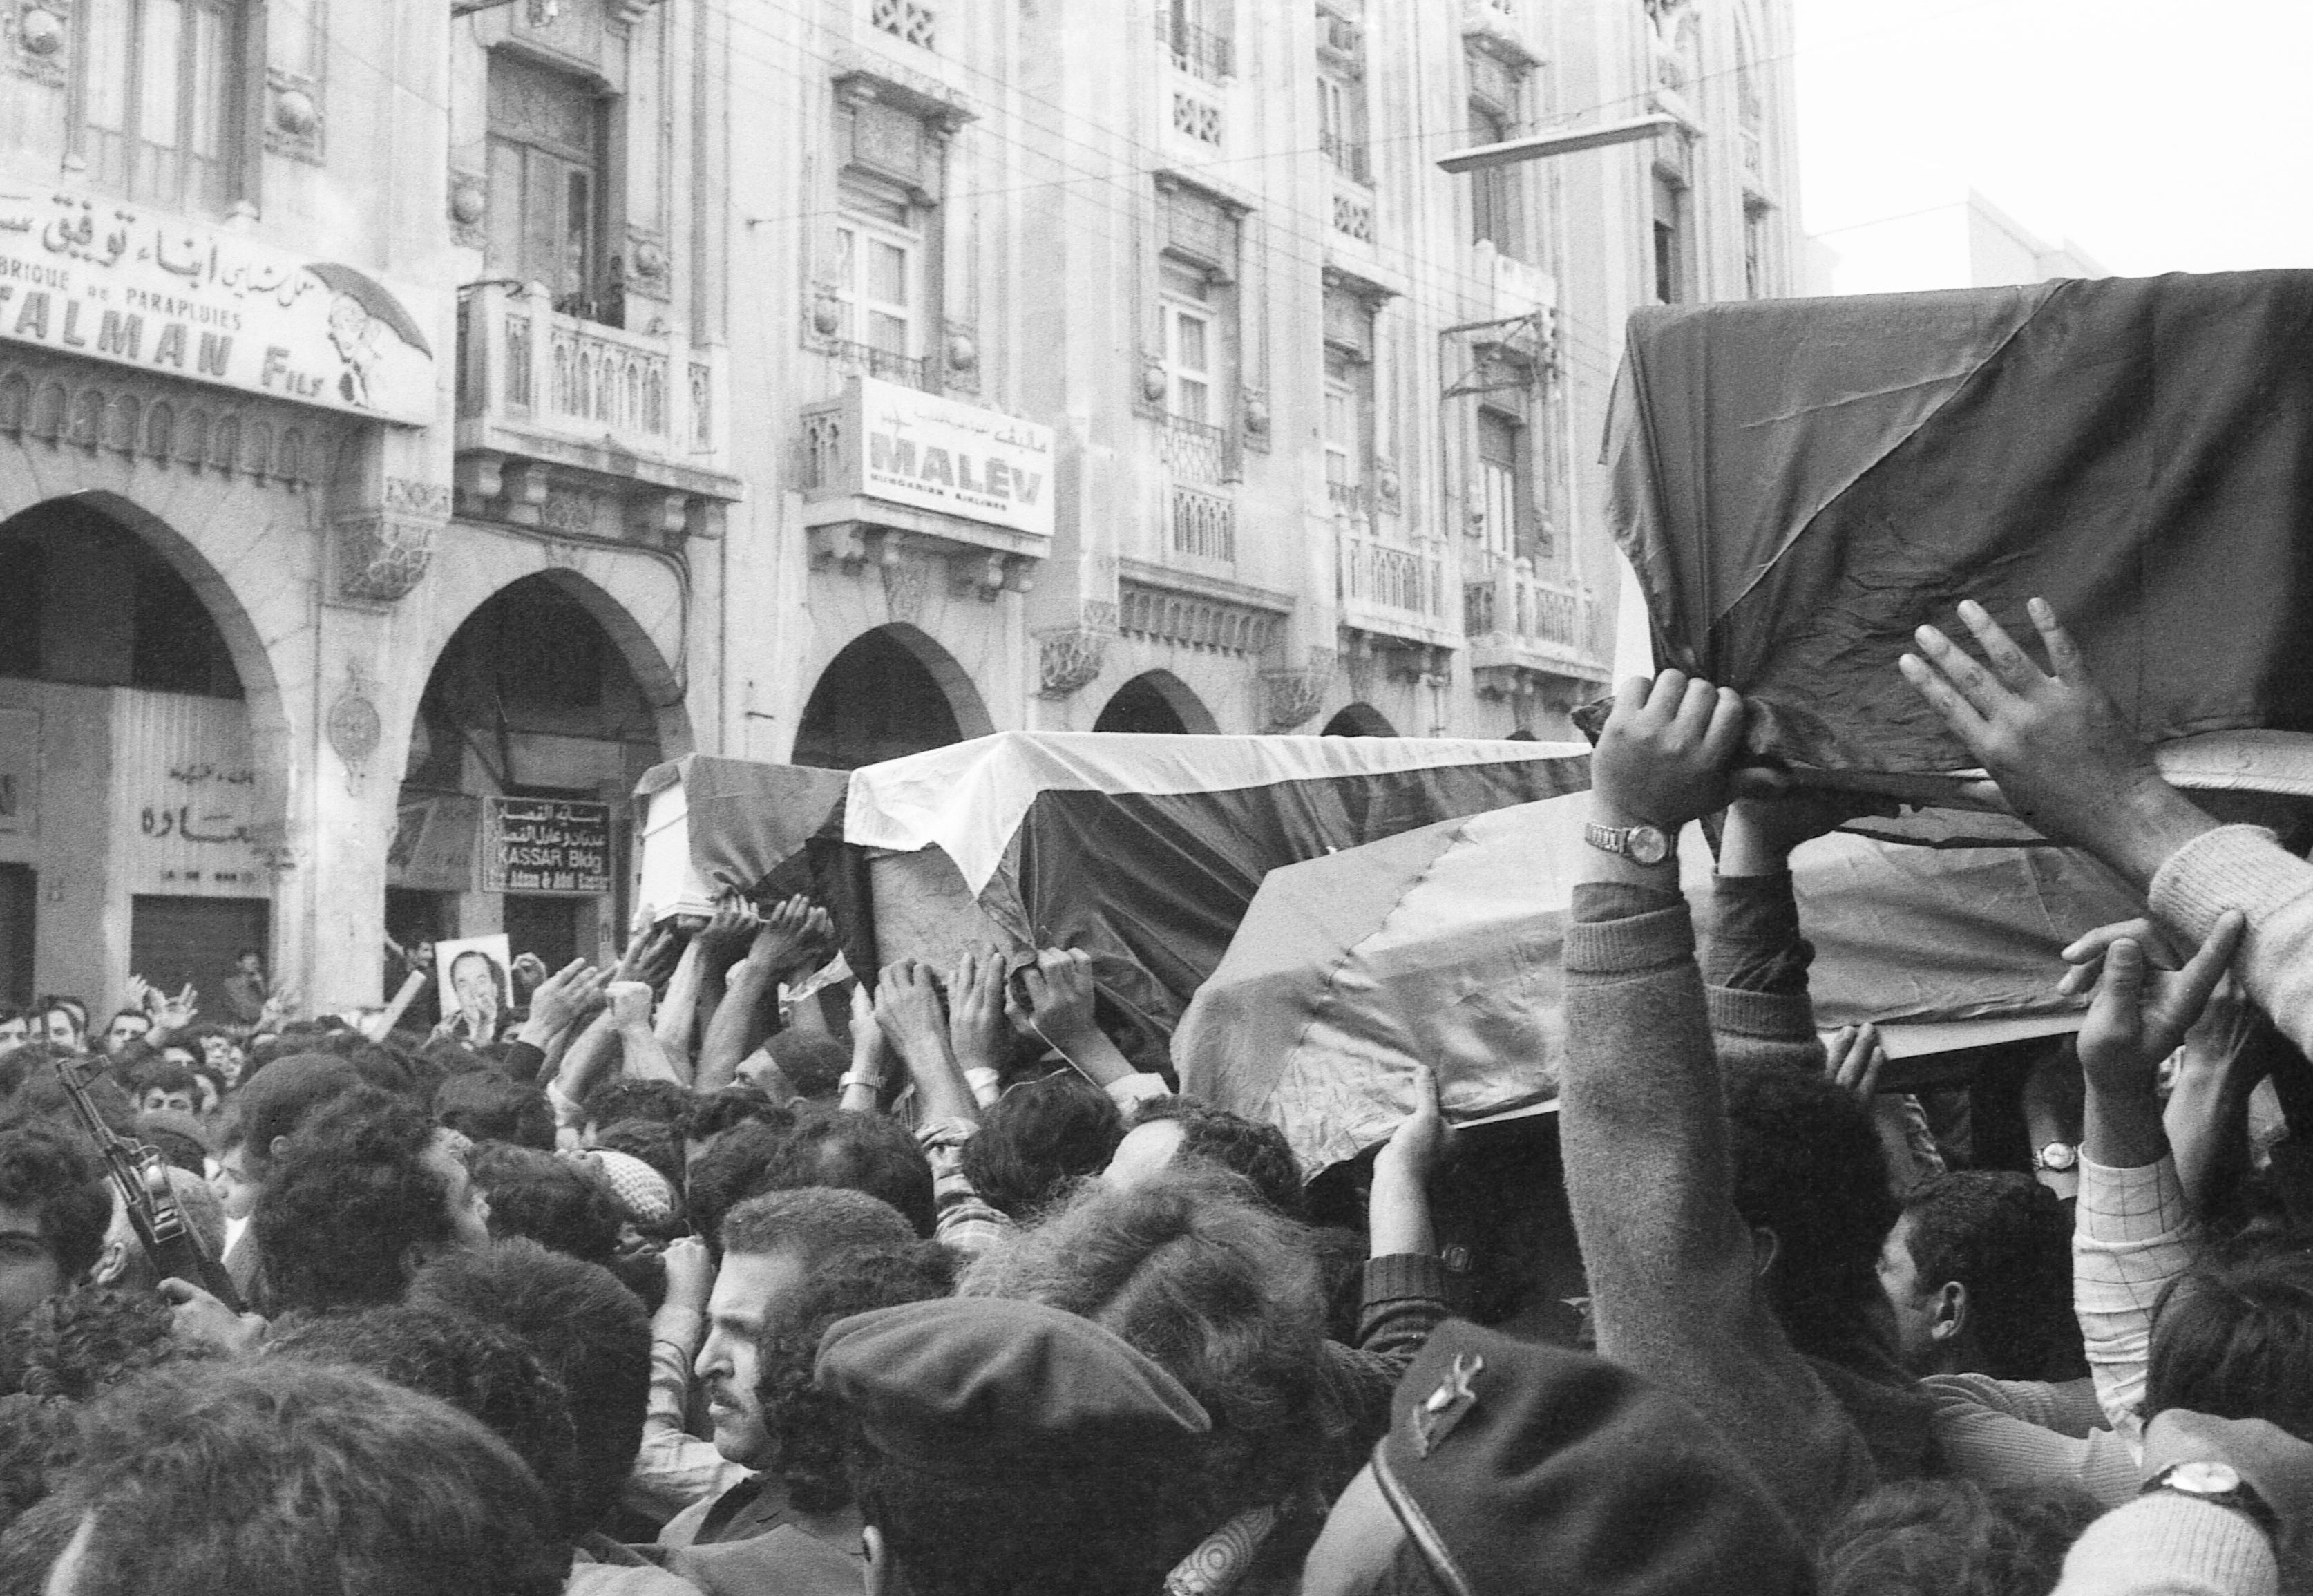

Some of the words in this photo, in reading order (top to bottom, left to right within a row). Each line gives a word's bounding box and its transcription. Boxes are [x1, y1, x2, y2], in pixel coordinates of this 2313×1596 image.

[41, 194, 136, 268] توفيق
[126, 287, 240, 330] PARAPLUIES
[497, 846, 562, 867] KASSAR
[569, 849, 602, 875] Bldg
